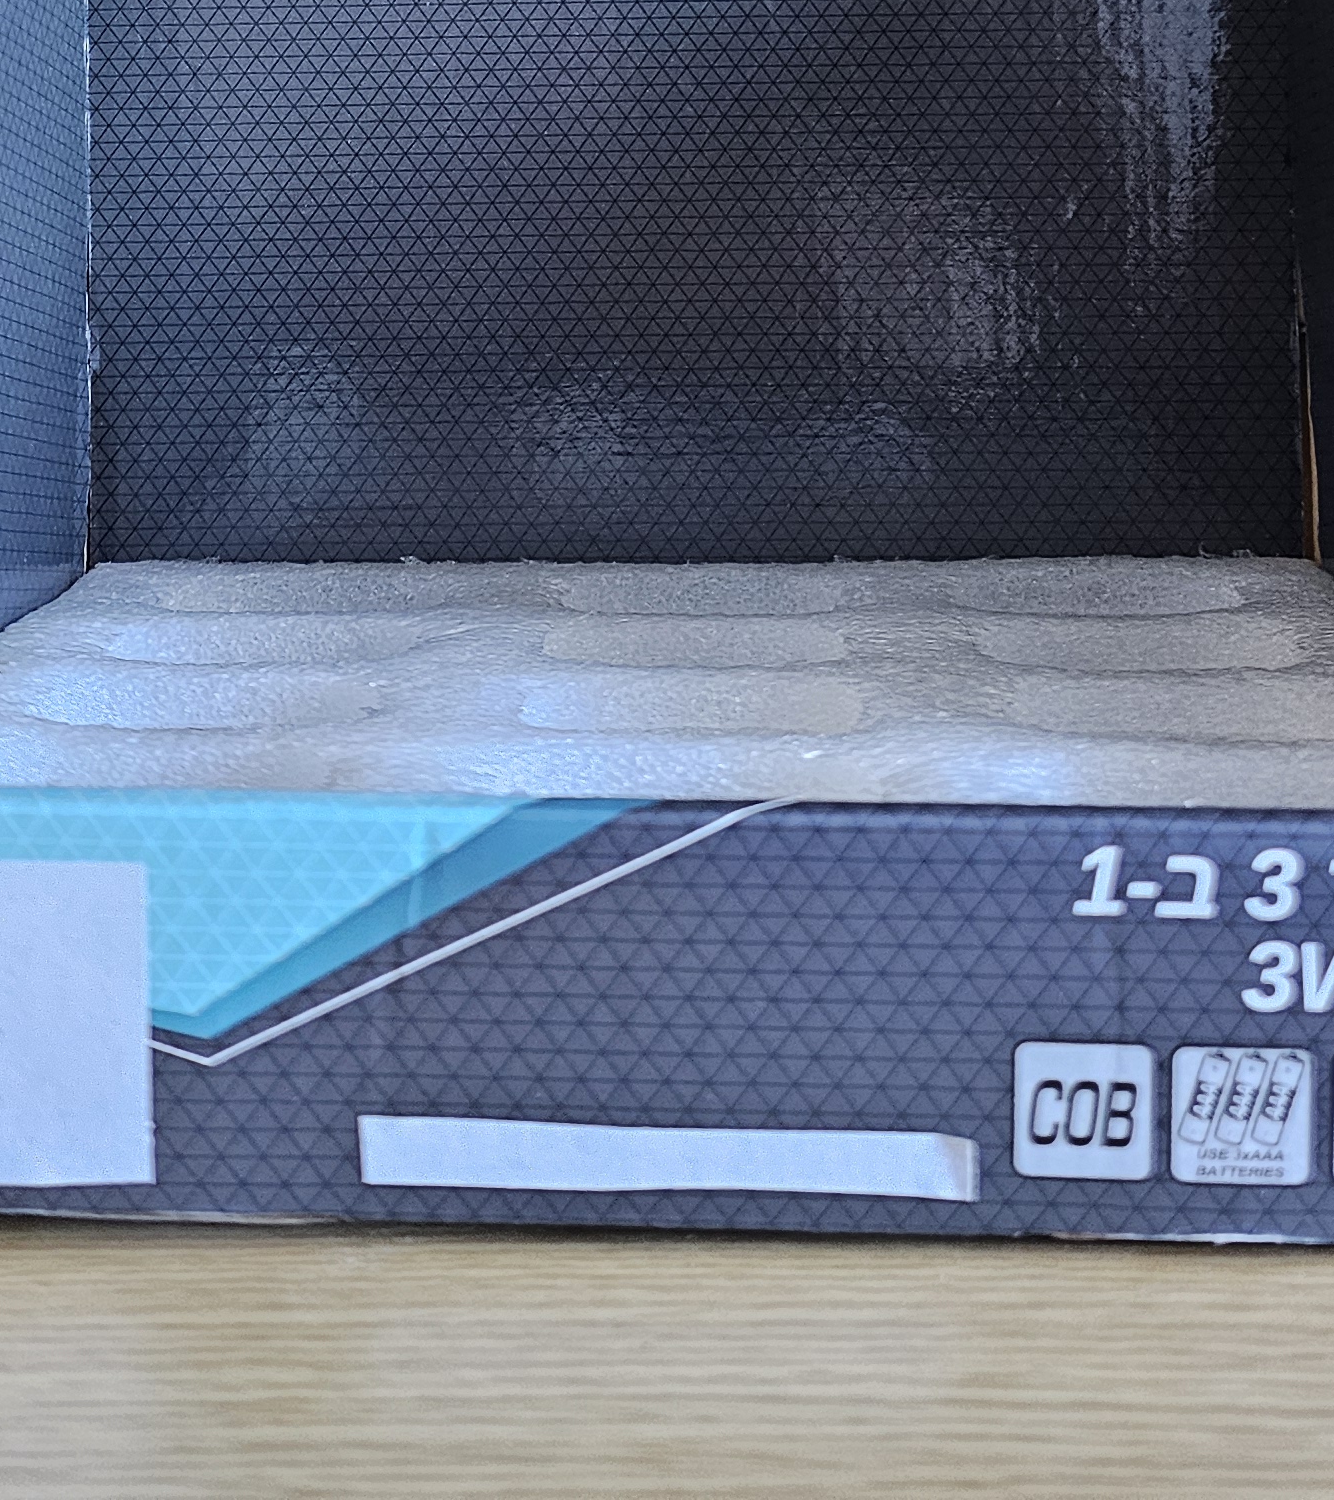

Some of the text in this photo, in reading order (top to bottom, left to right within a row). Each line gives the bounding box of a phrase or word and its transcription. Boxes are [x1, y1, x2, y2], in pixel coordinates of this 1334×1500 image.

[1243, 847, 1308, 921] 3
[1029, 1079, 1138, 1147] COB
[1195, 1165, 1285, 1178] BATTERIES
[1197, 1148, 1228, 1160] USE
